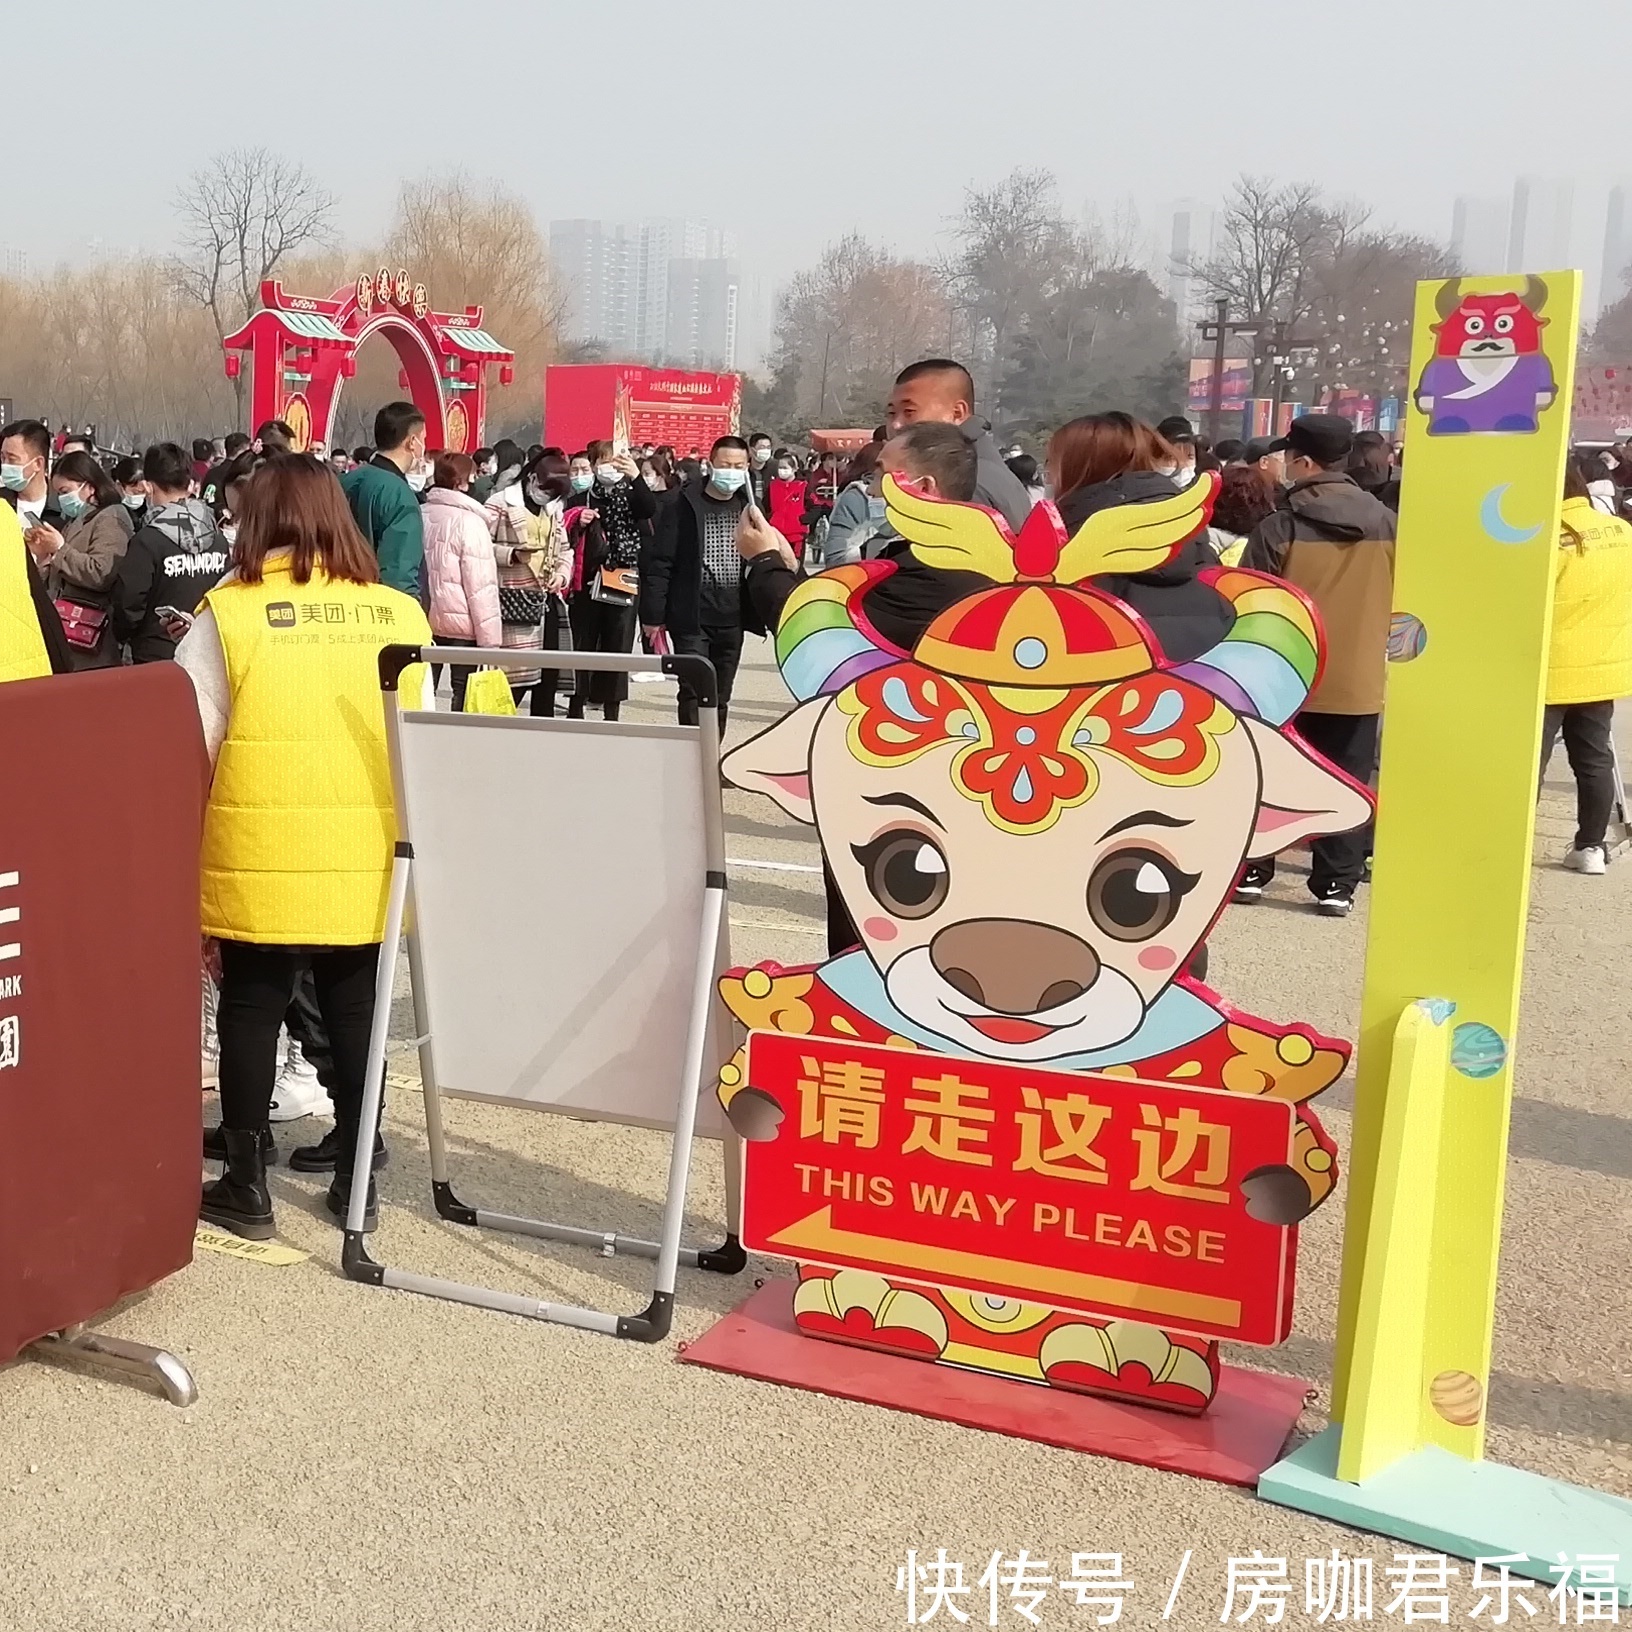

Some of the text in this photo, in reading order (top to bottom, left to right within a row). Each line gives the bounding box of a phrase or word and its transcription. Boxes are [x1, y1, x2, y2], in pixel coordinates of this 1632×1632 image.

[795, 1054, 1232, 1205] 请走这边
[793, 1162, 1227, 1264] THIS WAY PLEASE
